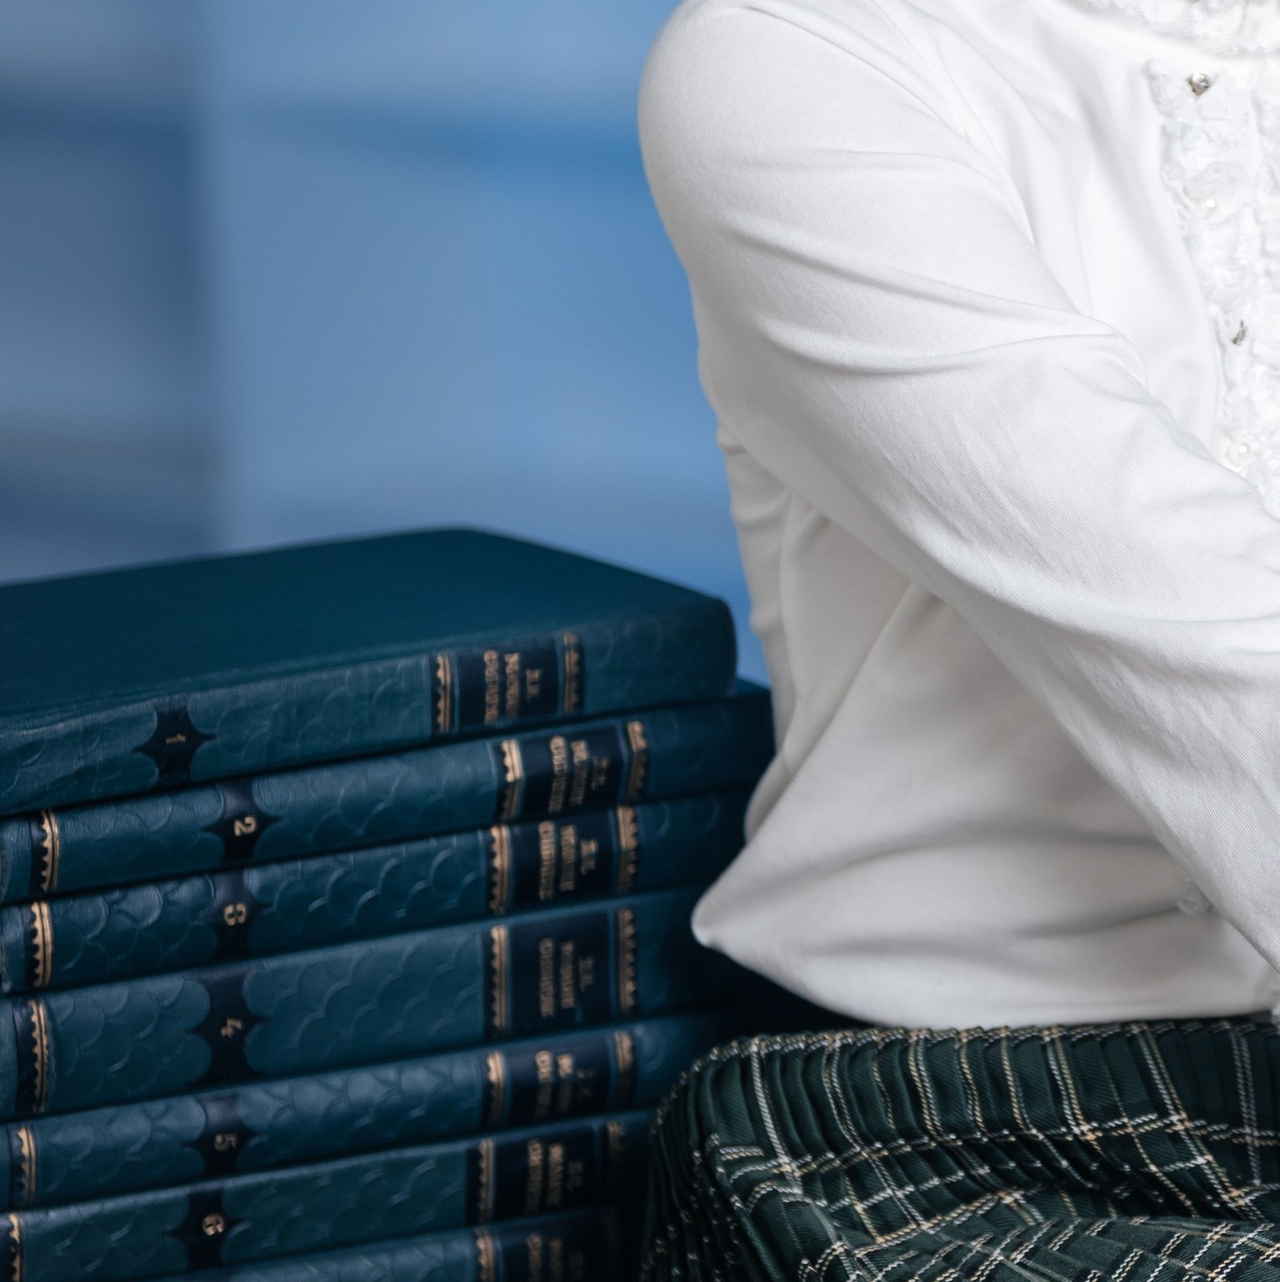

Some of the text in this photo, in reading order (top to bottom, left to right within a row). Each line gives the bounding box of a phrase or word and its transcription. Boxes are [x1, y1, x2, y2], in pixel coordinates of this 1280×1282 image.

[234, 815, 256, 836] 2
[224, 903, 246, 926] 3
[221, 1018, 242, 1038] 4
[214, 1132, 236, 1151] 5
[202, 1214, 224, 1236] 6
